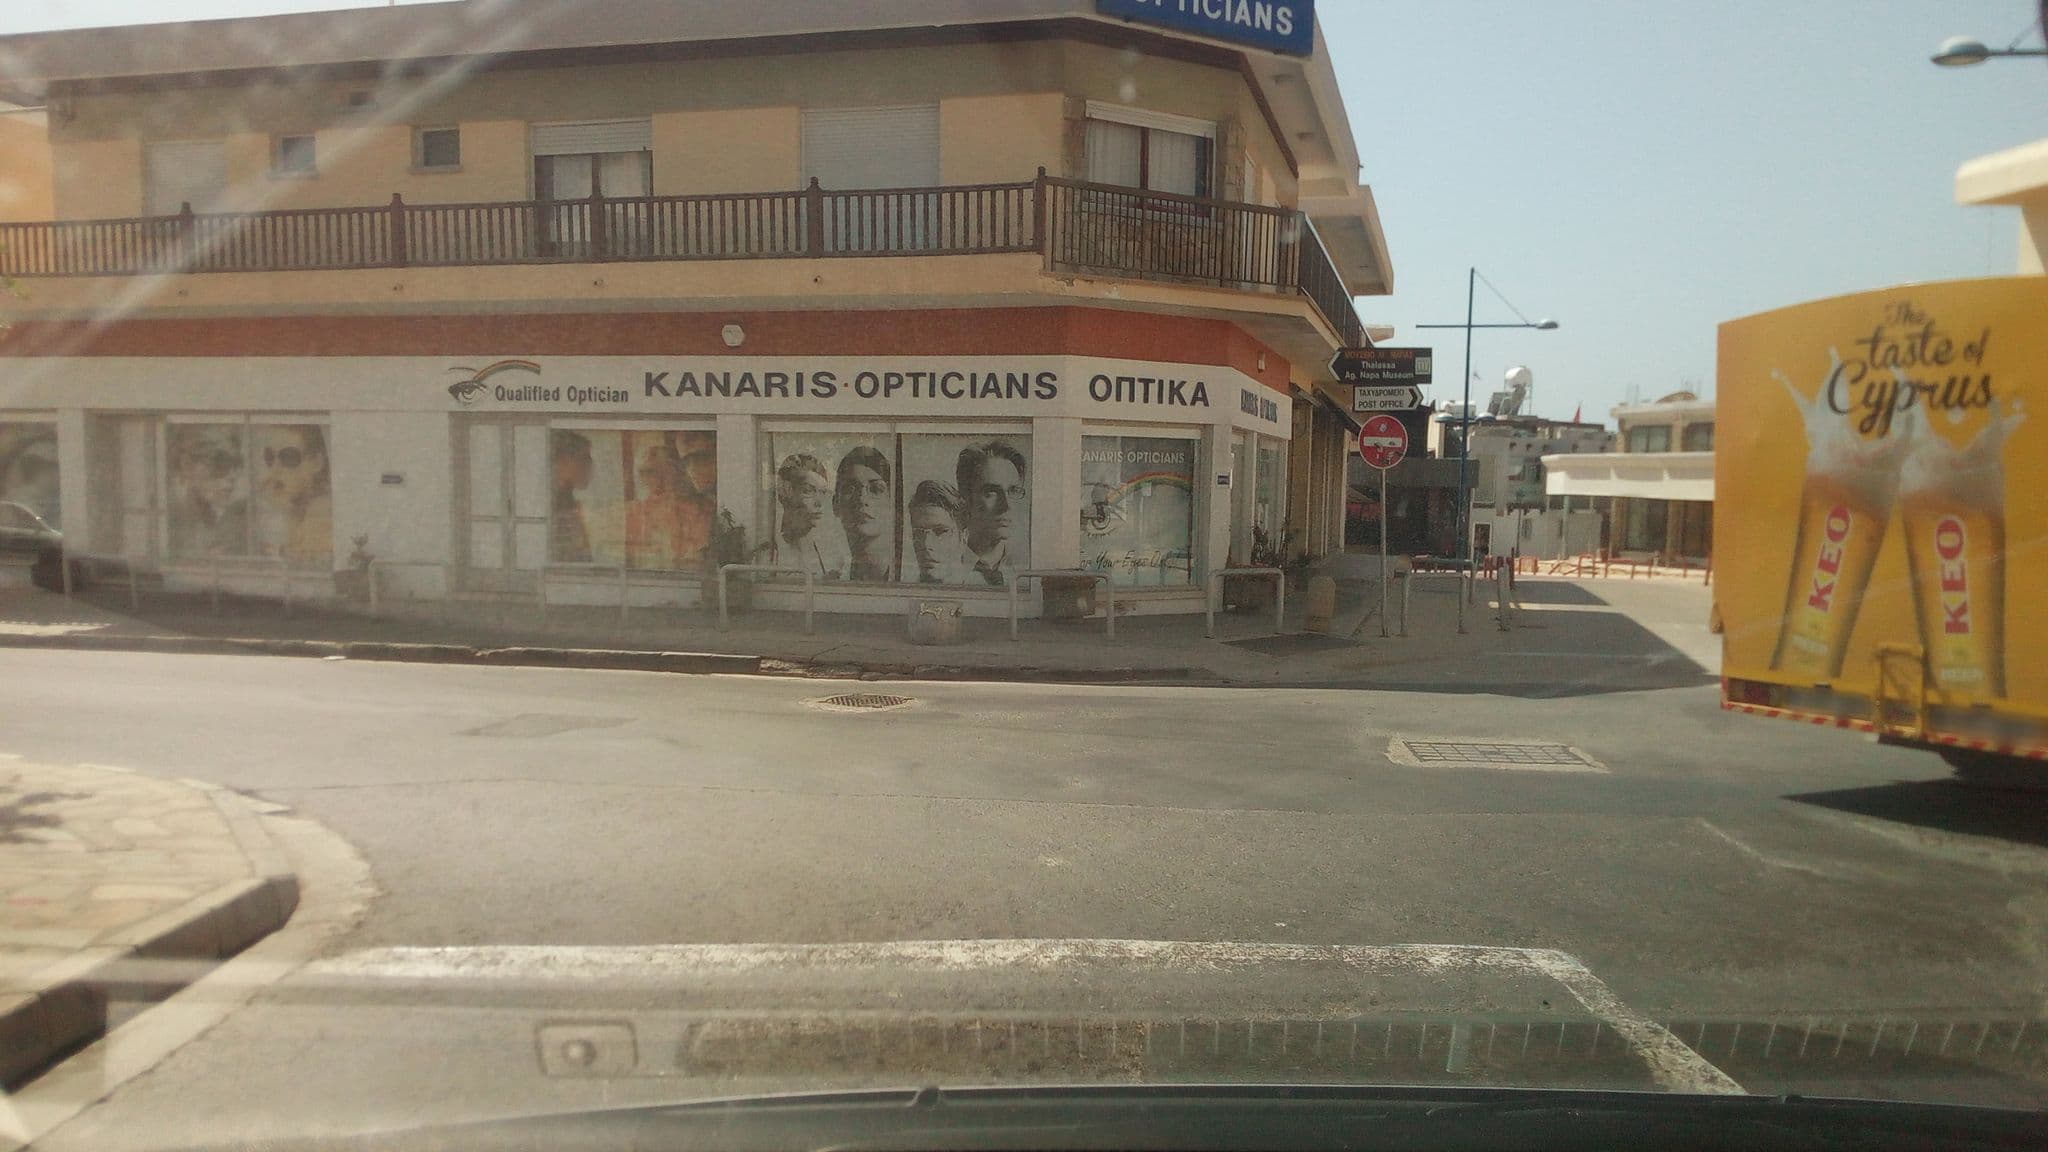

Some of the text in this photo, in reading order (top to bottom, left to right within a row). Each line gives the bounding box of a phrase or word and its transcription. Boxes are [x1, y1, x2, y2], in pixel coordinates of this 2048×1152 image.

[1856, 318, 1991, 369] taste of
[495, 385, 629, 405] Qualified Optician
[645, 371, 1058, 400] KANARIS OPTICIANS
[1358, 400, 1404, 409] POST OFFICE
[1828, 359, 1992, 438] Cyprus
[1127, 451, 1185, 464] OPTICIANS
[1807, 506, 1851, 613] KEO
[1936, 518, 1970, 635] KEO
